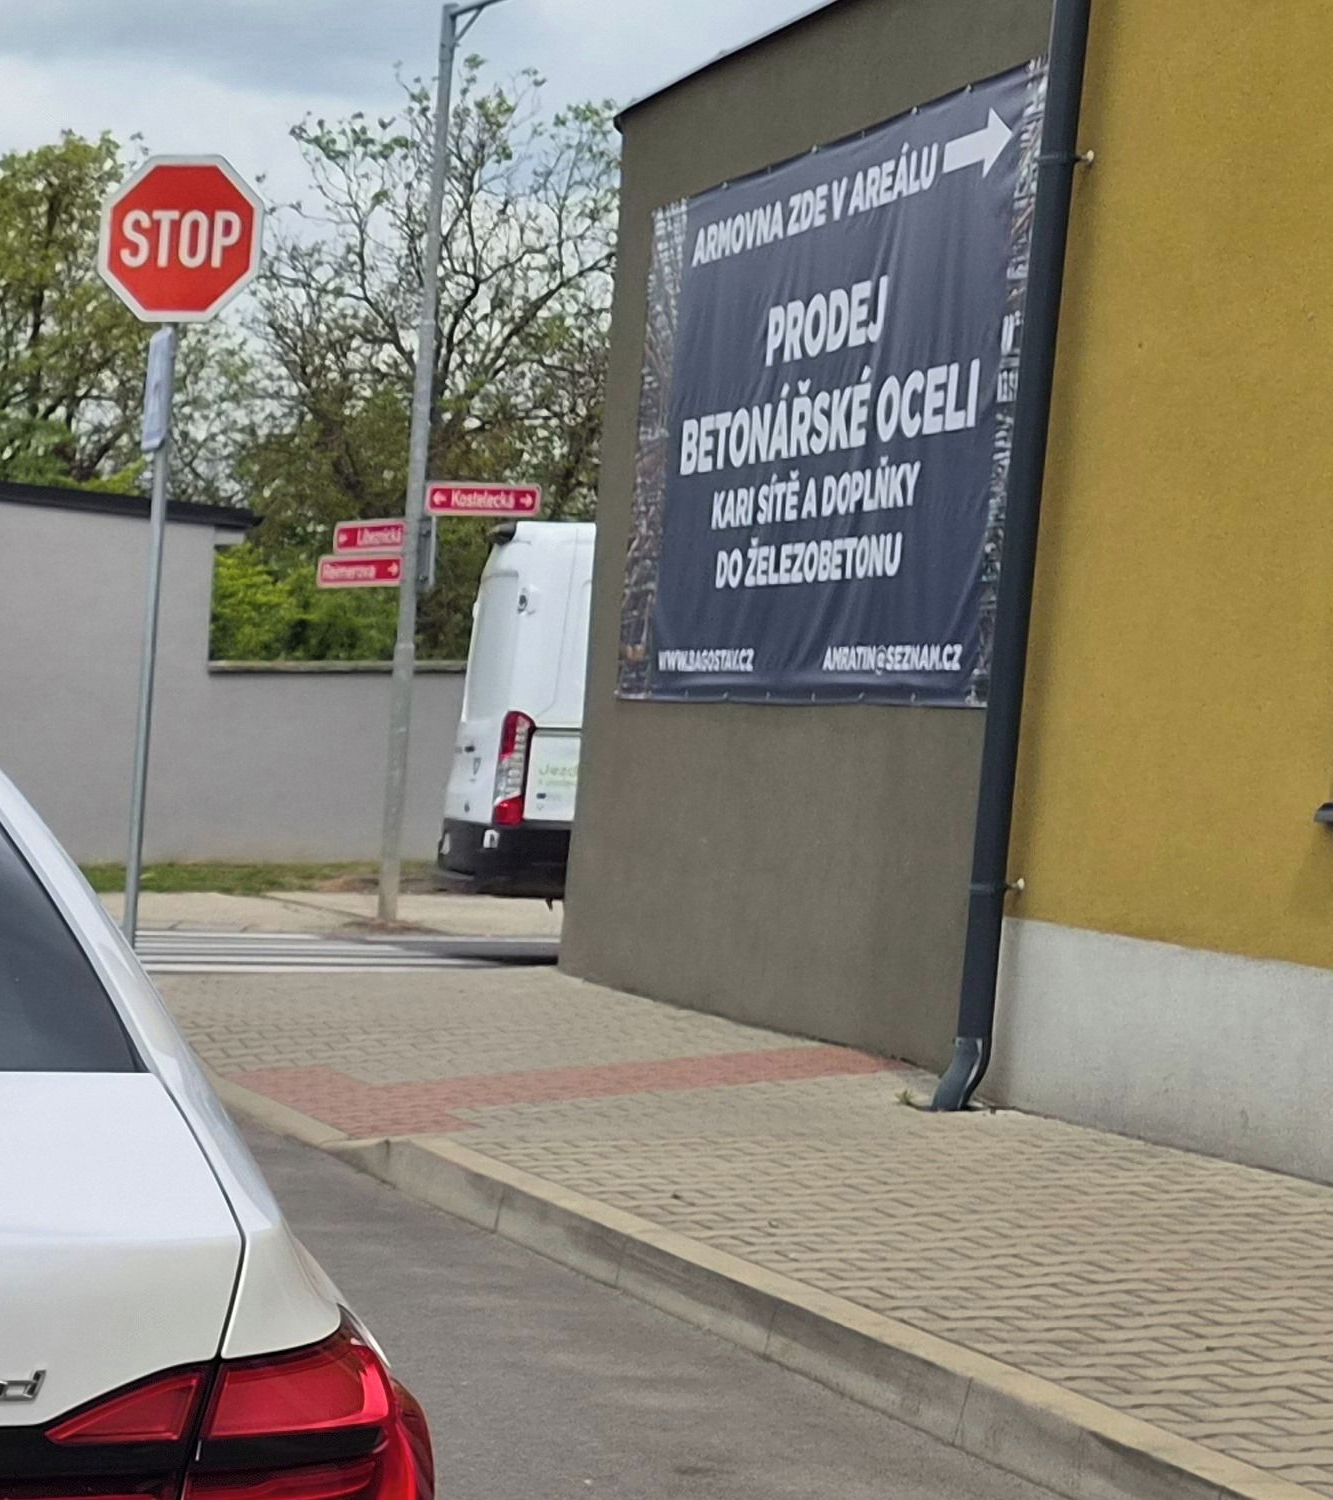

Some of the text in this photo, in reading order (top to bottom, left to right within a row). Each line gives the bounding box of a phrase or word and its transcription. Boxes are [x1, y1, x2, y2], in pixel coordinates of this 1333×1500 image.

[119, 209, 241, 268] STOP
[691, 142, 939, 268] ARMOVNA ZDE V AREÁLU
[765, 274, 889, 367] PRODEJ
[679, 358, 981, 475] BETONÁŘSKÉ OCELI
[711, 455, 921, 530] KARI SÍTĚ A DOPLŇKY
[715, 532, 903, 589] DO ŽELEZOBETONU
